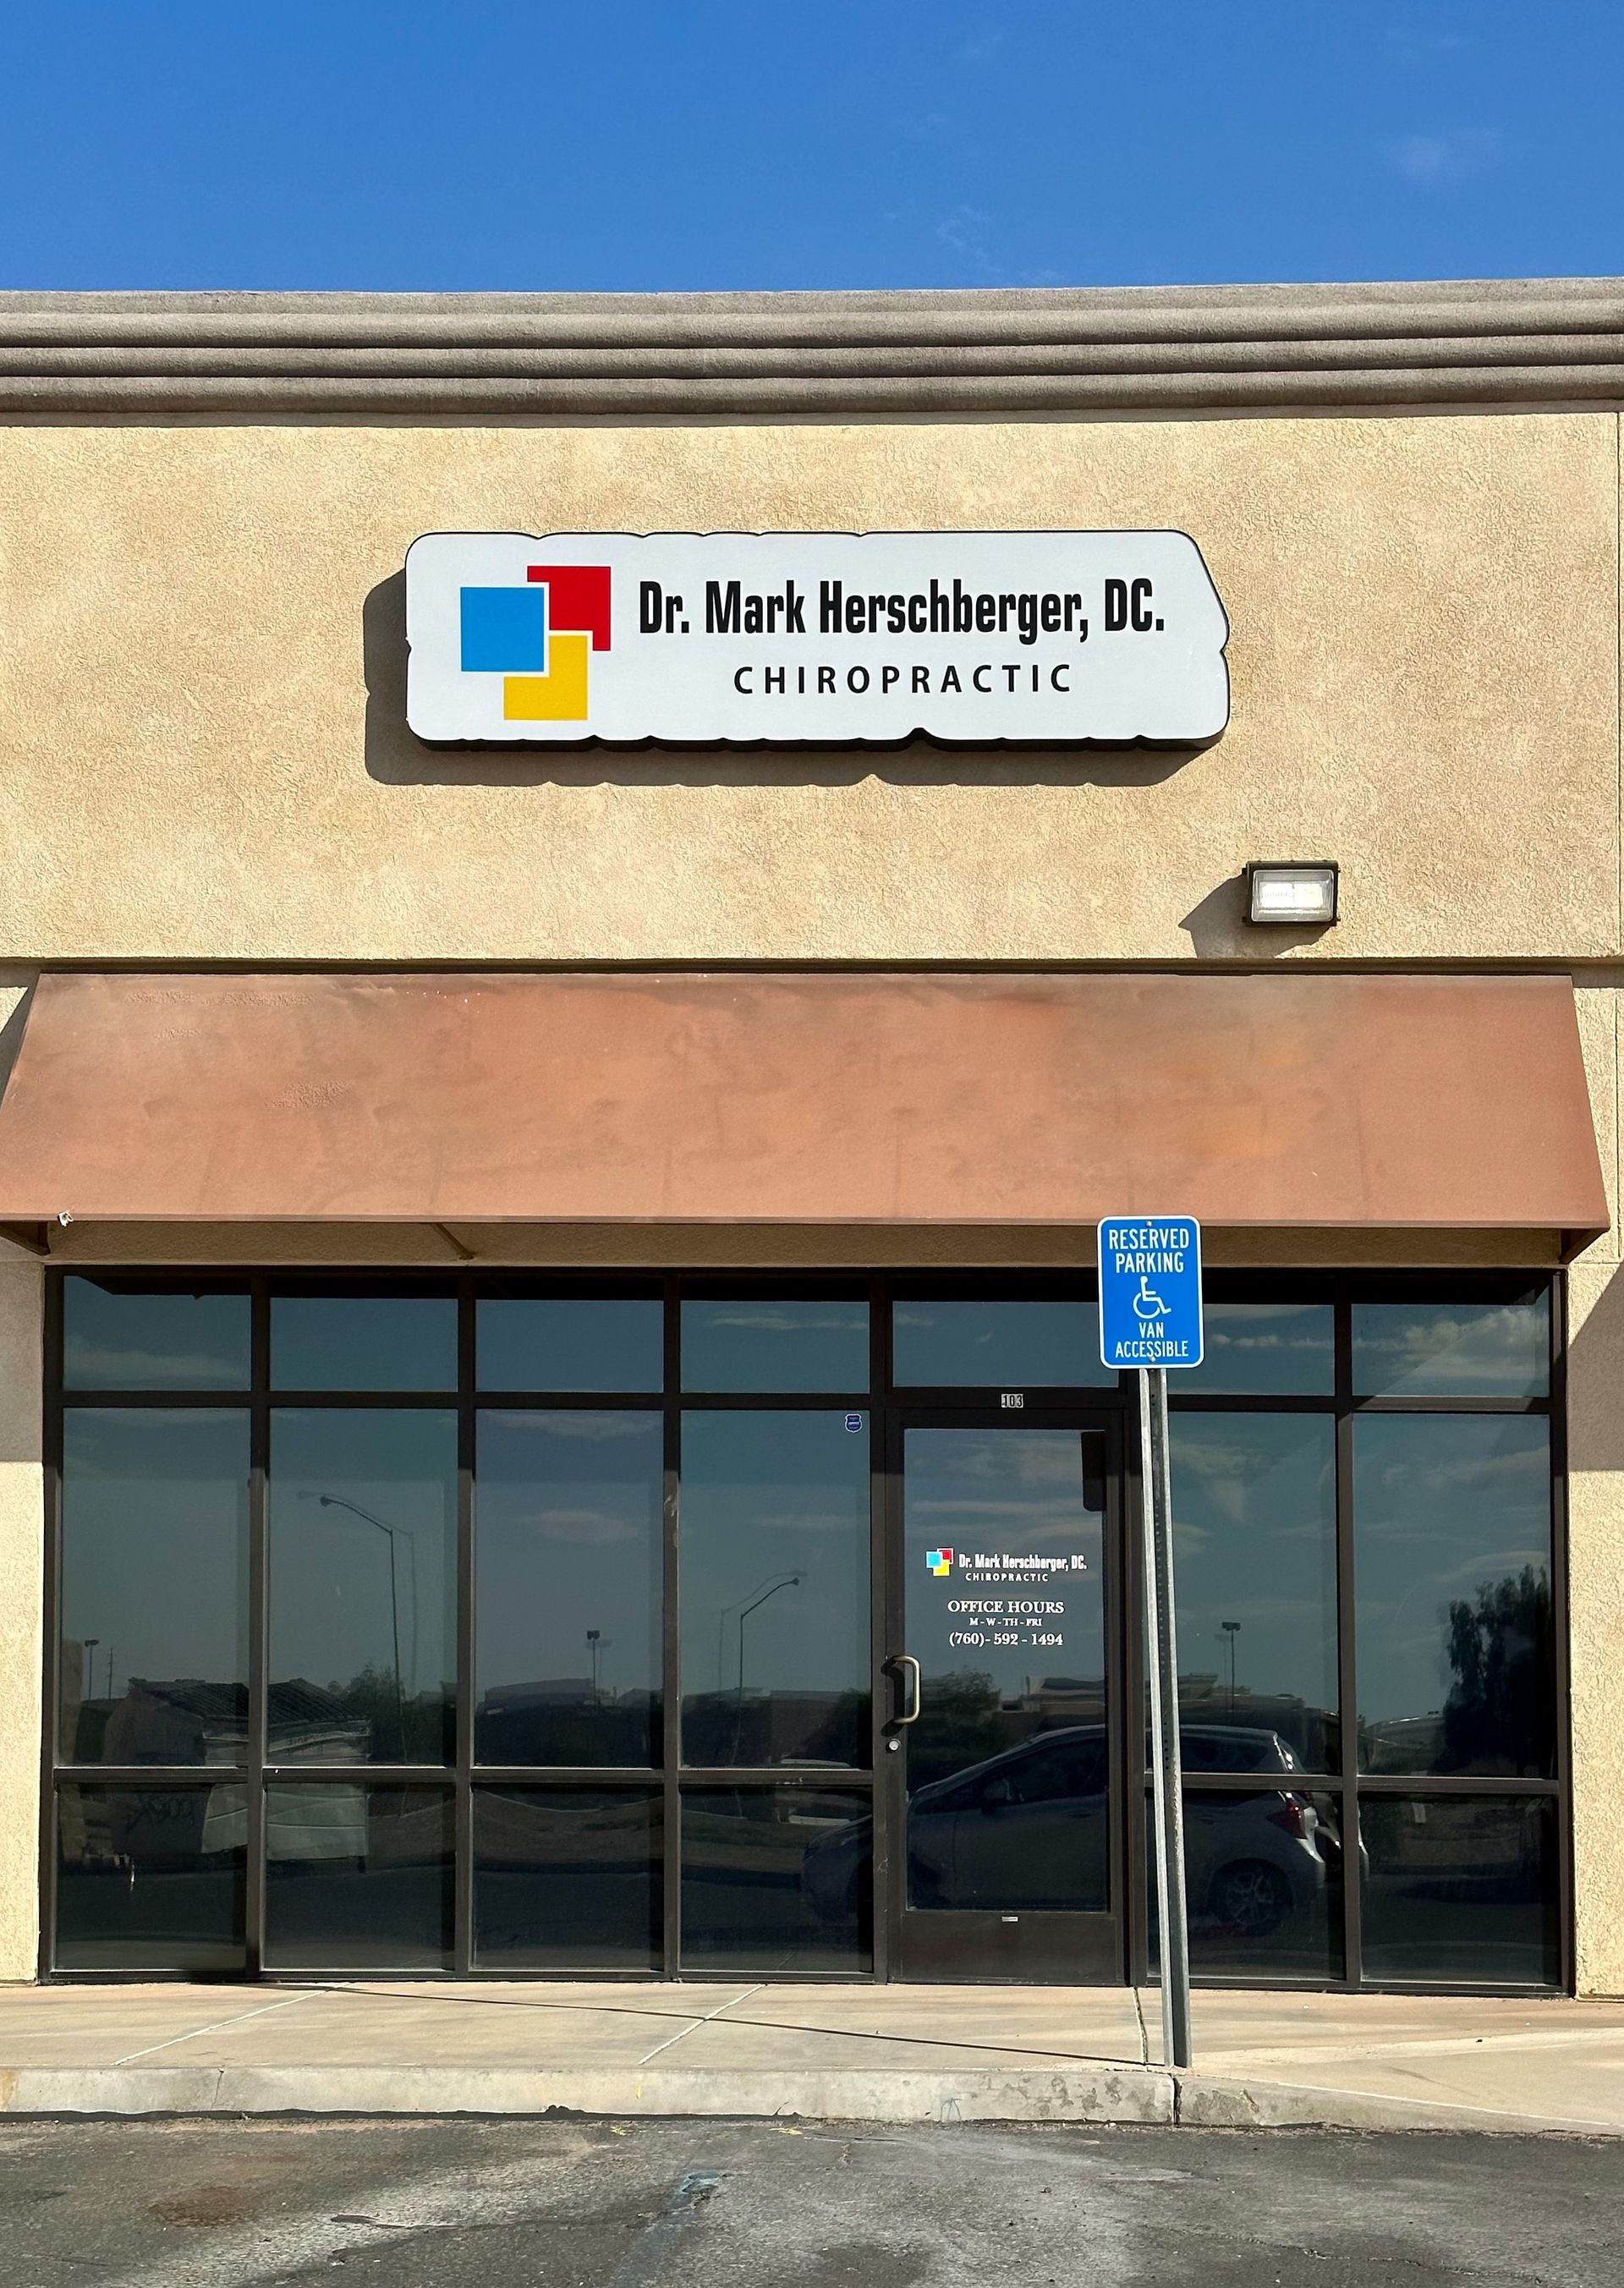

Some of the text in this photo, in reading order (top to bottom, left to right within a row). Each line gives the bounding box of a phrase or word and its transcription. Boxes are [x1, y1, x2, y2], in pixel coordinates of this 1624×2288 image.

[639, 578, 1165, 645] Dr. Mark Herschberger, DC.
[733, 664, 1070, 694] CHIROPRACTIC
[1109, 1228, 1189, 1250] RESERVED
[1116, 1252, 1184, 1273] PARKING
[1138, 1322, 1164, 1339] VAN
[1115, 1340, 1189, 1358] ACCESSIBLE
[1002, 1394, 1023, 1407] 103
[958, 1553, 973, 1569] Dr.
[974, 1553, 1001, 1569] Mark
[1071, 1555, 1088, 1570] DC.
[965, 1572, 1049, 1583] CHIROPRACTIC
[947, 1599, 1065, 1614] OFFICE HOURS
